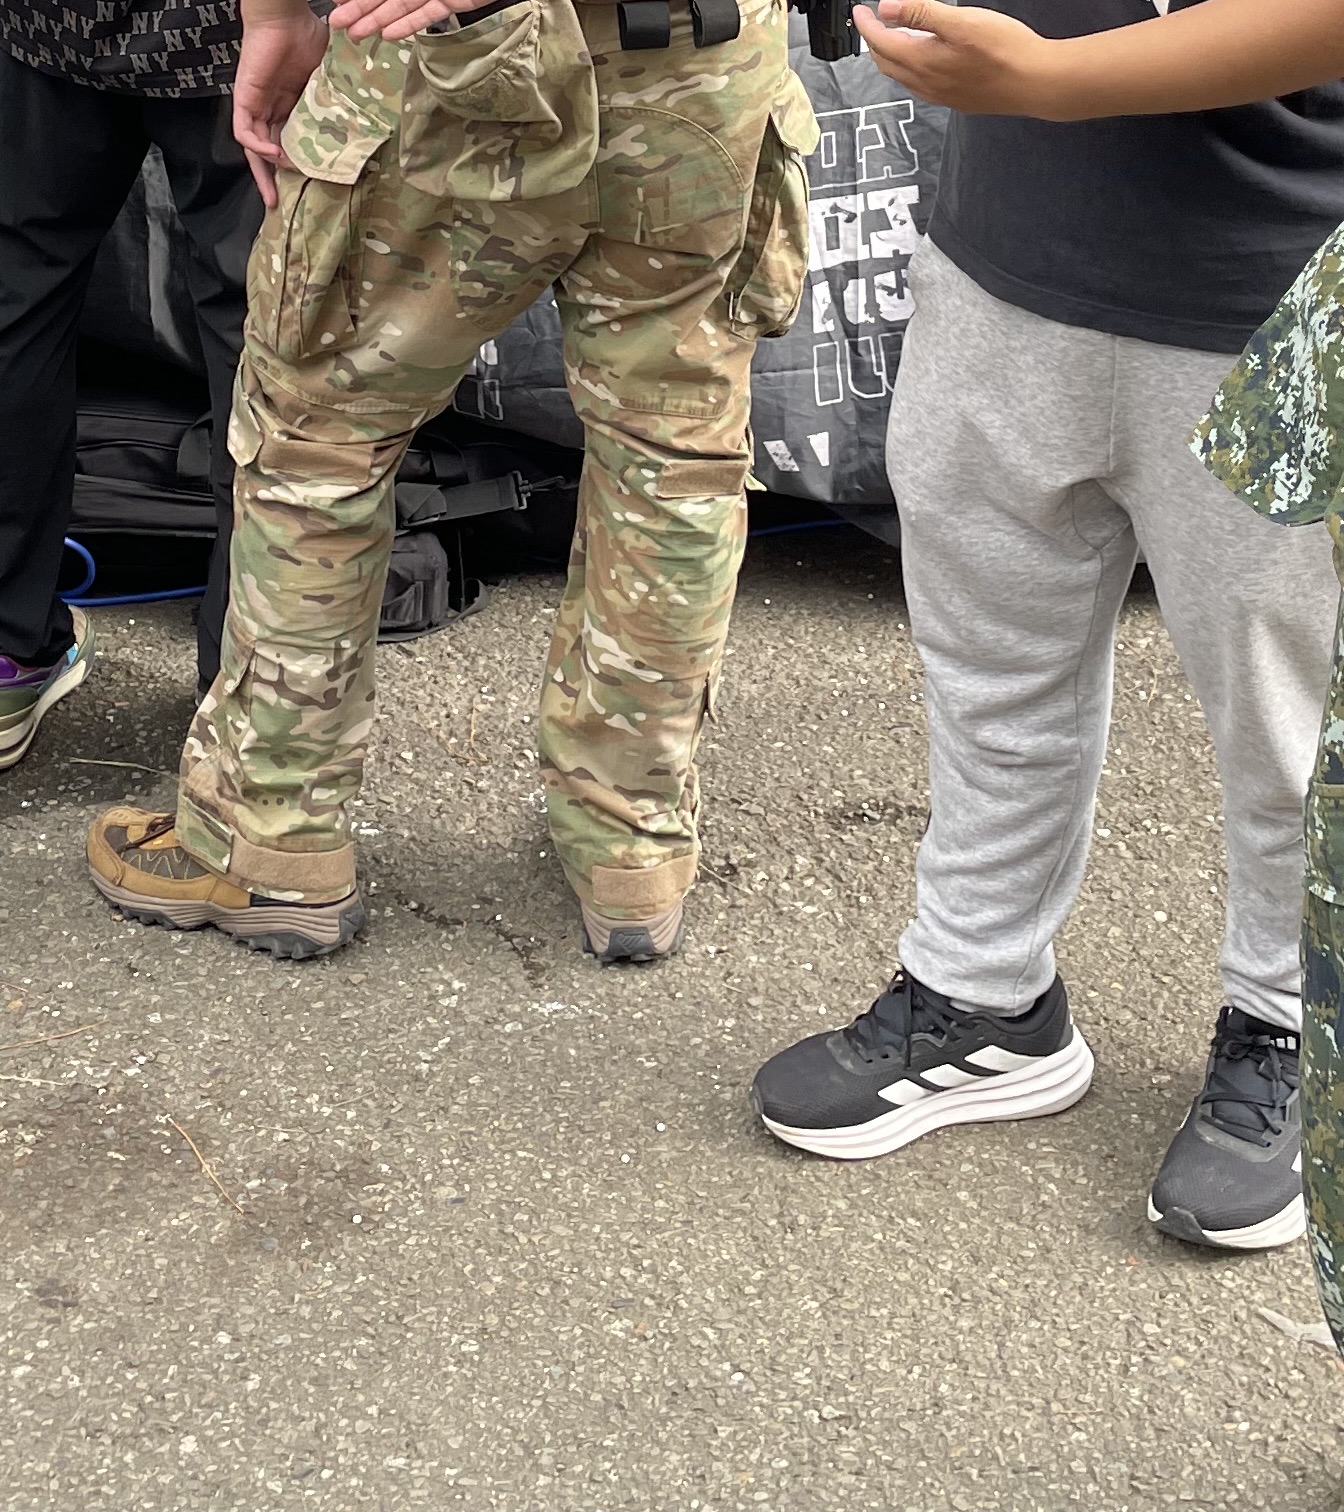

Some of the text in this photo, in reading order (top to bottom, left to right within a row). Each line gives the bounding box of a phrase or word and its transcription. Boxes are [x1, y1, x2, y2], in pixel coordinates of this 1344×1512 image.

[34, 9, 62, 40] NY
[133, 9, 164, 32] NY
[198, 0, 236, 26] NY
[164, 28, 202, 50] NY
[62, 45, 93, 71] NY
[132, 52, 168, 73] NY
[176, 65, 213, 88] NY
